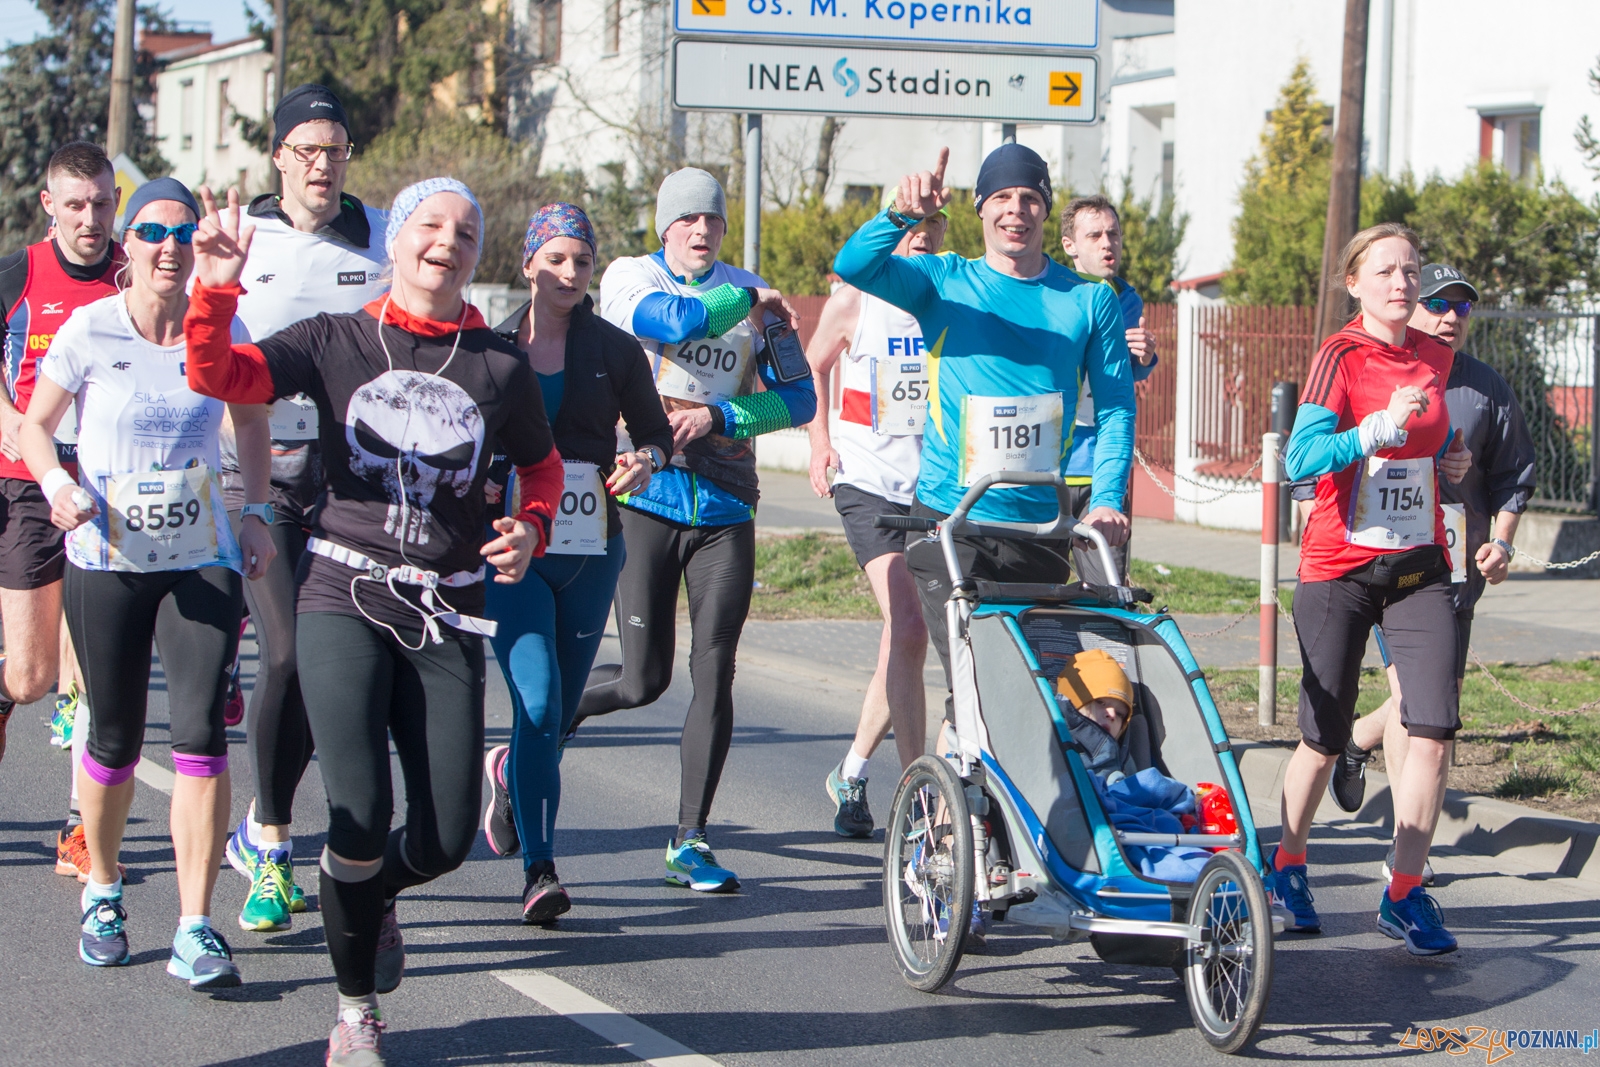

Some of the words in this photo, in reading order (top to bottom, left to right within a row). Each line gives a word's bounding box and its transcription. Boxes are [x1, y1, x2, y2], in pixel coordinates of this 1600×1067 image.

[865, 0, 1032, 28] Kopernika
[748, 64, 824, 92] INEA
[866, 67, 991, 98] Stadion
[677, 341, 737, 372] 4010
[696, 370, 715, 379] Marek
[134, 392, 166, 404] SIŁA
[144, 406, 209, 418] ODWAGA
[134, 419, 209, 432] SZYBKOŚĆ
[989, 424, 1041, 449] 1181
[1378, 487, 1424, 511] 1154
[126, 498, 200, 532] 8559
[1387, 514, 1417, 522] Agnieszka
